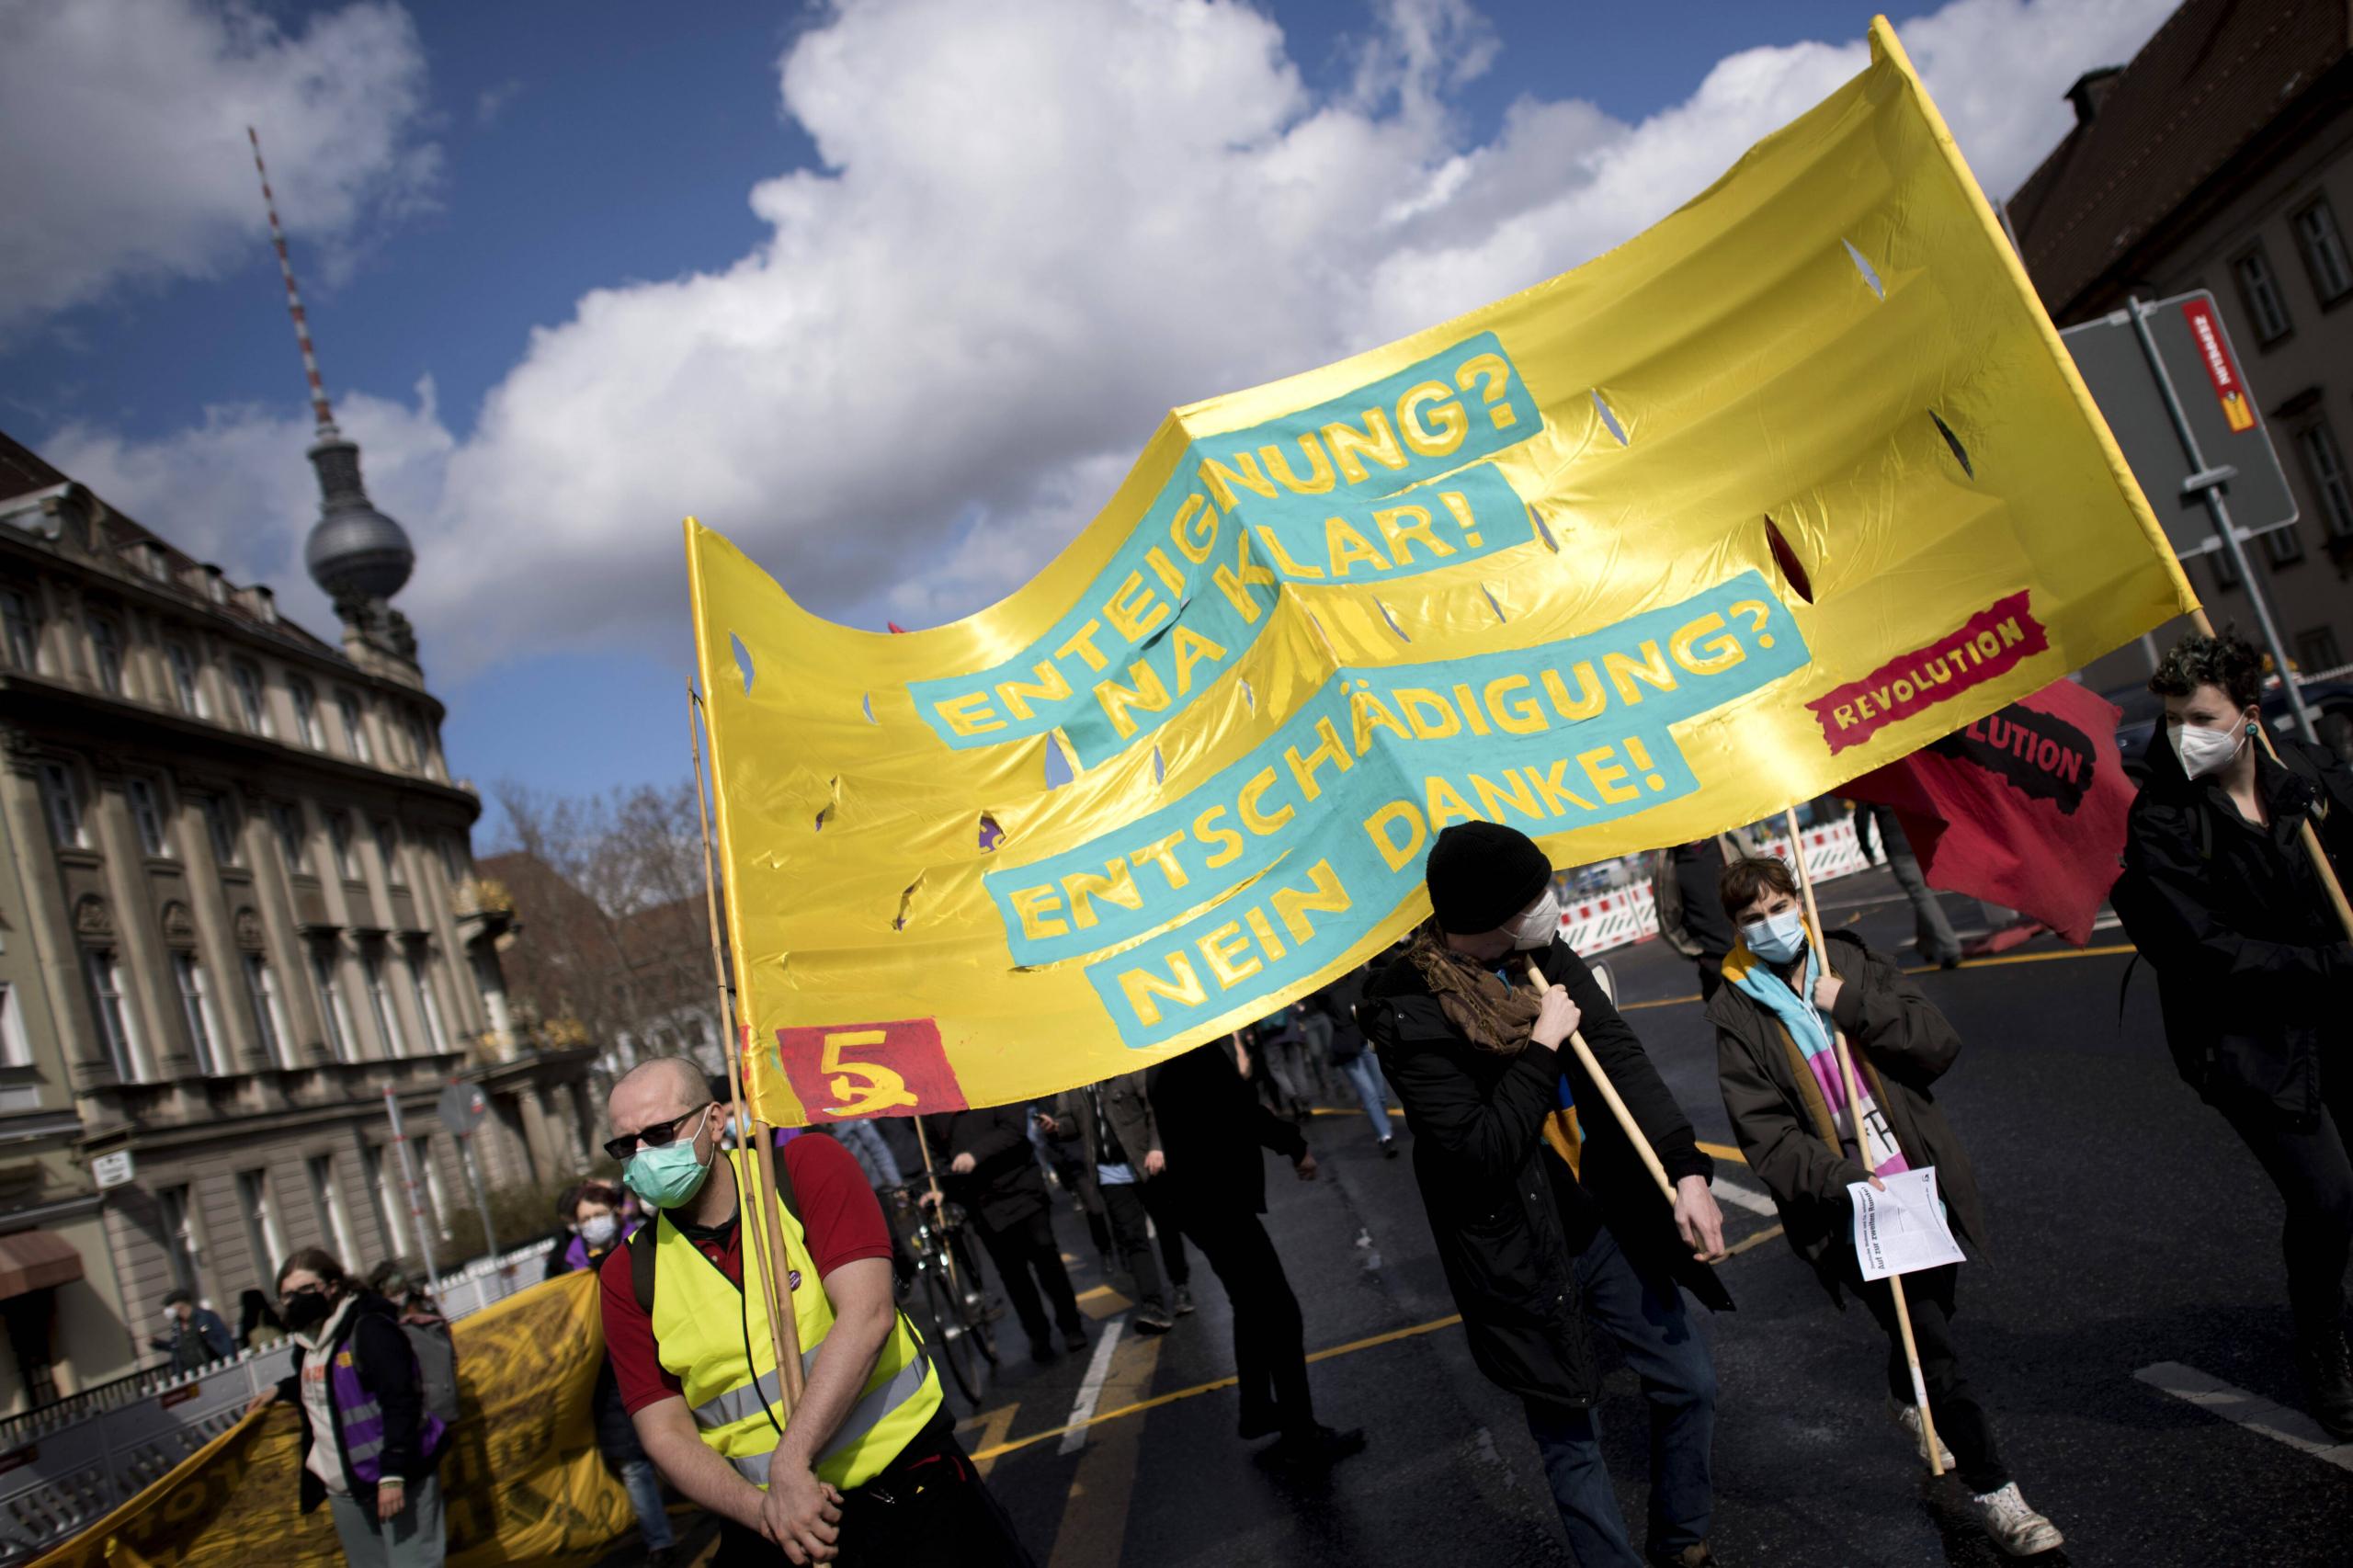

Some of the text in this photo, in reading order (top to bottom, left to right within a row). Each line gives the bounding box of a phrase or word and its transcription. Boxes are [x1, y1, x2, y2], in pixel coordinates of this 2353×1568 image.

[933, 353, 1518, 737] ENTEIGNUNG?
[1092, 491, 1485, 740] NA KLAR!
[1832, 616, 2026, 732] REVOLUTION
[1007, 599, 1777, 941] ENTSCHÄDIGUNG?
[1117, 735, 1666, 1028] NEIN DANKE!
[1965, 714, 2083, 785] LUTION
